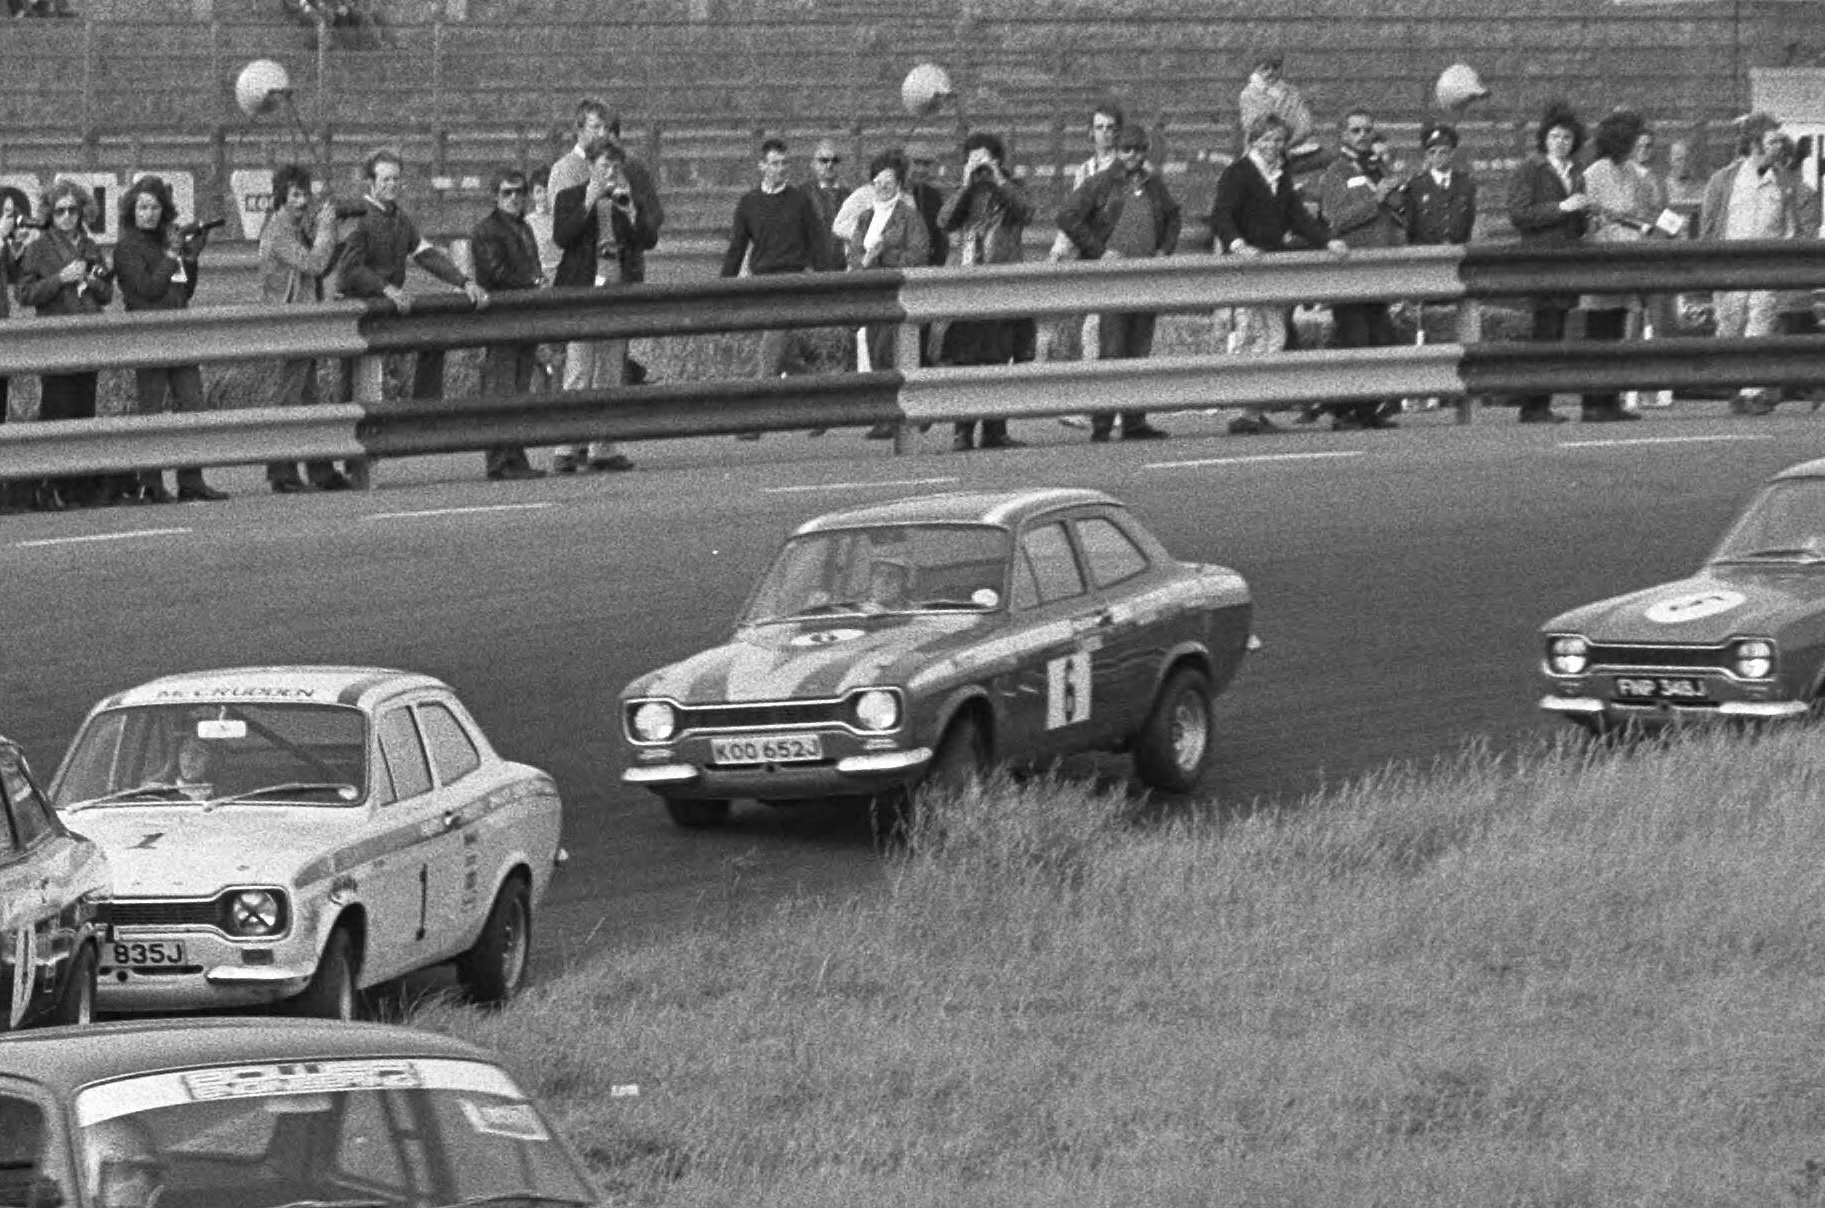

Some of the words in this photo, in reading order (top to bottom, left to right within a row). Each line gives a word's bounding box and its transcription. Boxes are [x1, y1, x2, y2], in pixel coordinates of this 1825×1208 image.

[1063, 658, 1077, 722] 6
[126, 832, 164, 850] 1
[416, 863, 428, 941] 1
